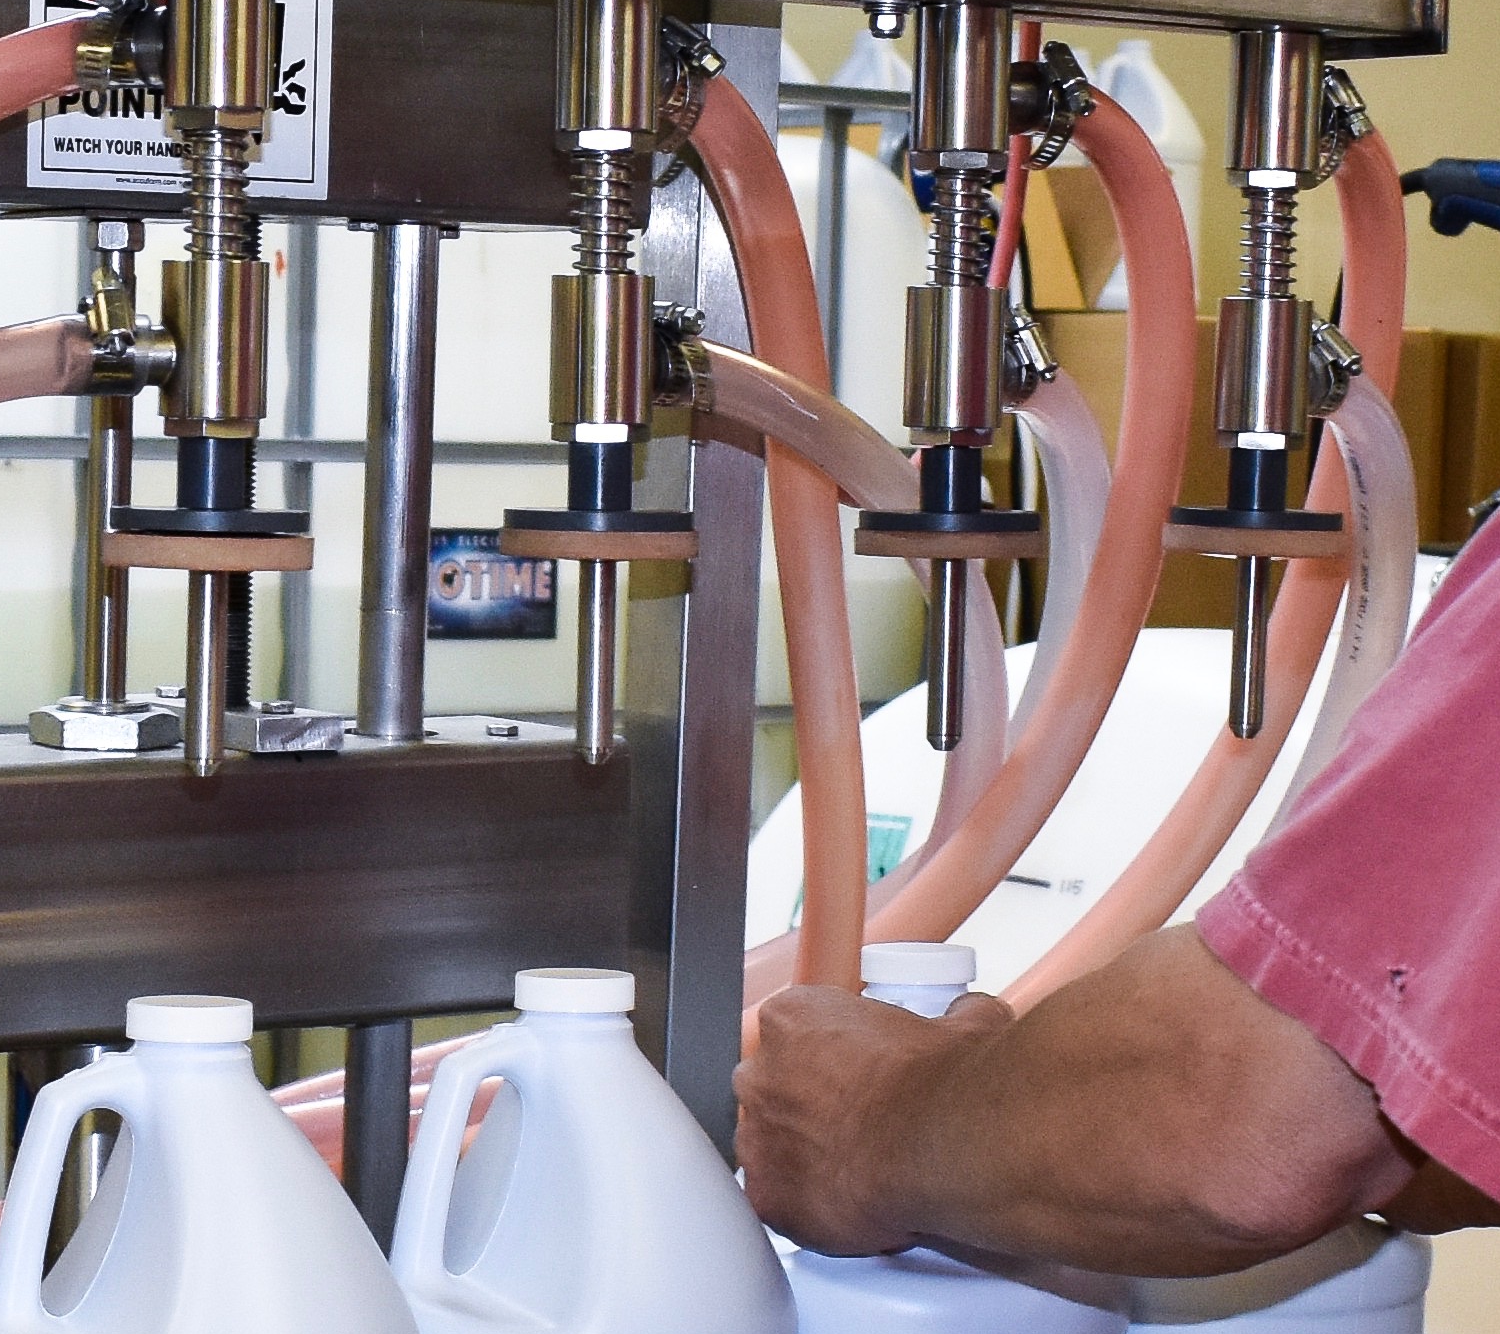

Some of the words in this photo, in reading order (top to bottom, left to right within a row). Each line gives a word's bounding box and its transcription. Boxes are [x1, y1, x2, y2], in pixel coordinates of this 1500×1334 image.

[54, 136, 101, 153] WATCH
[106, 138, 142, 156] YOUR
[147, 140, 192, 158] HANDS
